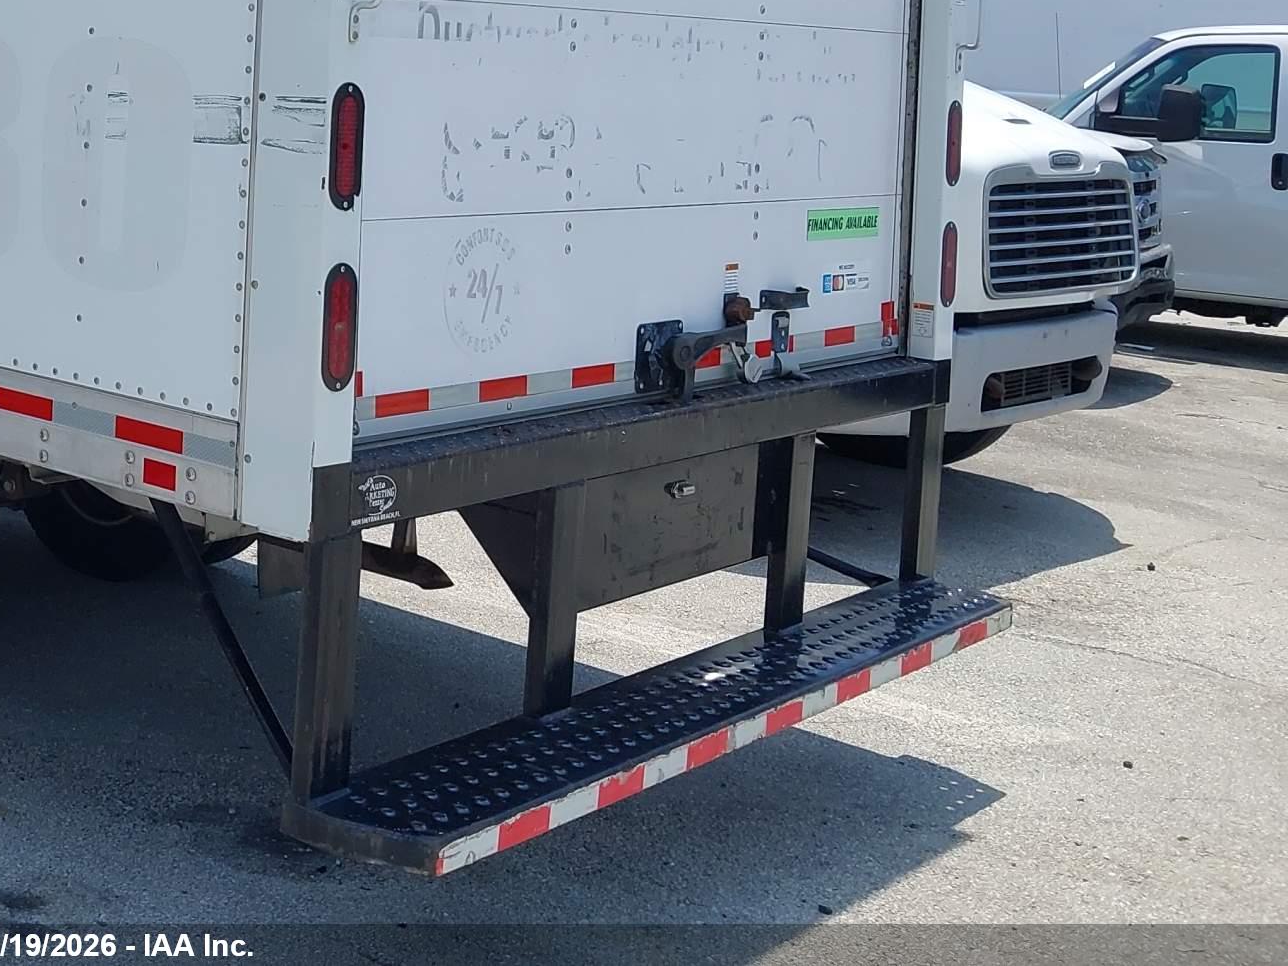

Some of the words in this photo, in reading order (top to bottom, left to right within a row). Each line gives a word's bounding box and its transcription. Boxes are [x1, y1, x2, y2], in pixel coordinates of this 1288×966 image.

[808, 217, 844, 232] FINANCING
[845, 215, 878, 230] AVAILABLE
[369, 481, 386, 492] Auto
